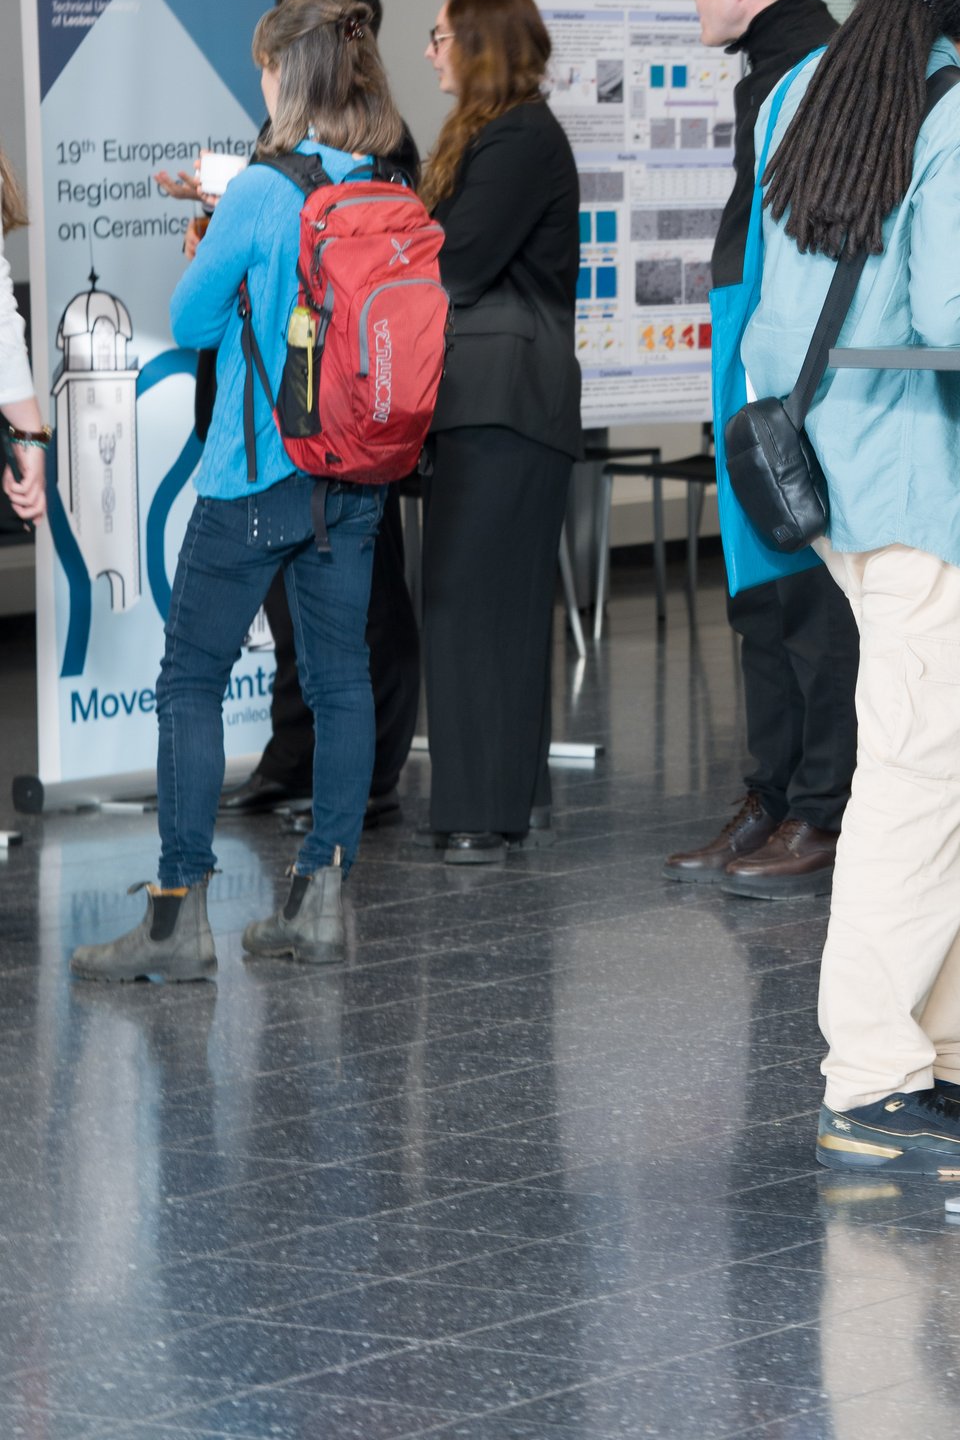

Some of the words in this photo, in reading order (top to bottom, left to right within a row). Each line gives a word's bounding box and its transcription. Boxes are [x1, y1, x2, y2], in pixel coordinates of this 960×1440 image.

[103, 137, 201, 167] European
[58, 176, 151, 208] Regional
[58, 222, 86, 242] on
[93, 213, 188, 240] Ceramics
[373, 320, 392, 423] MONTURA
[71, 687, 156, 724] Move
